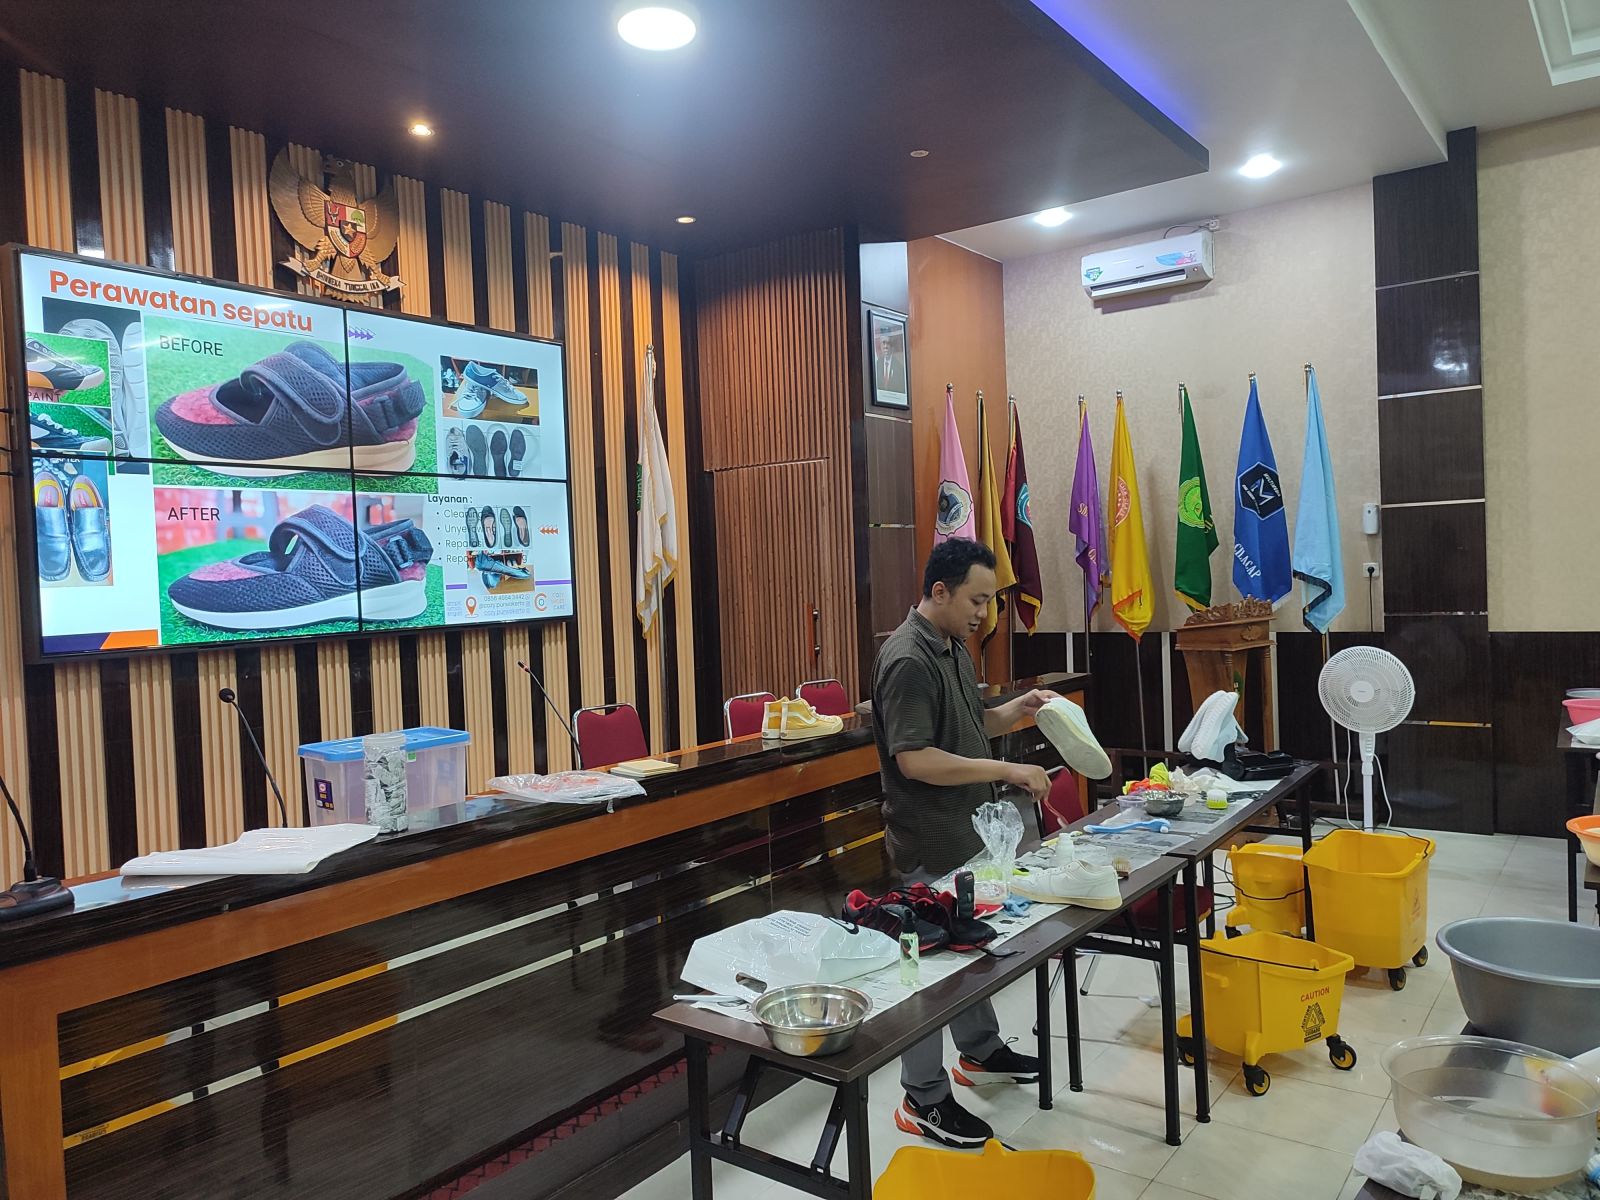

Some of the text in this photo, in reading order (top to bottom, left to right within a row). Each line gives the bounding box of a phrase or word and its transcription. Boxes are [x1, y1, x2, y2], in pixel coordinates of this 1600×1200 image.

[49, 270, 313, 332] Perawatan sepatu
[159, 335, 224, 357] BEFORE
[428, 494, 468, 505] Layanan
[167, 507, 220, 521] AFTER
[1234, 543, 1262, 579] CILACAP
[1300, 986, 1330, 1002] CAUTION
